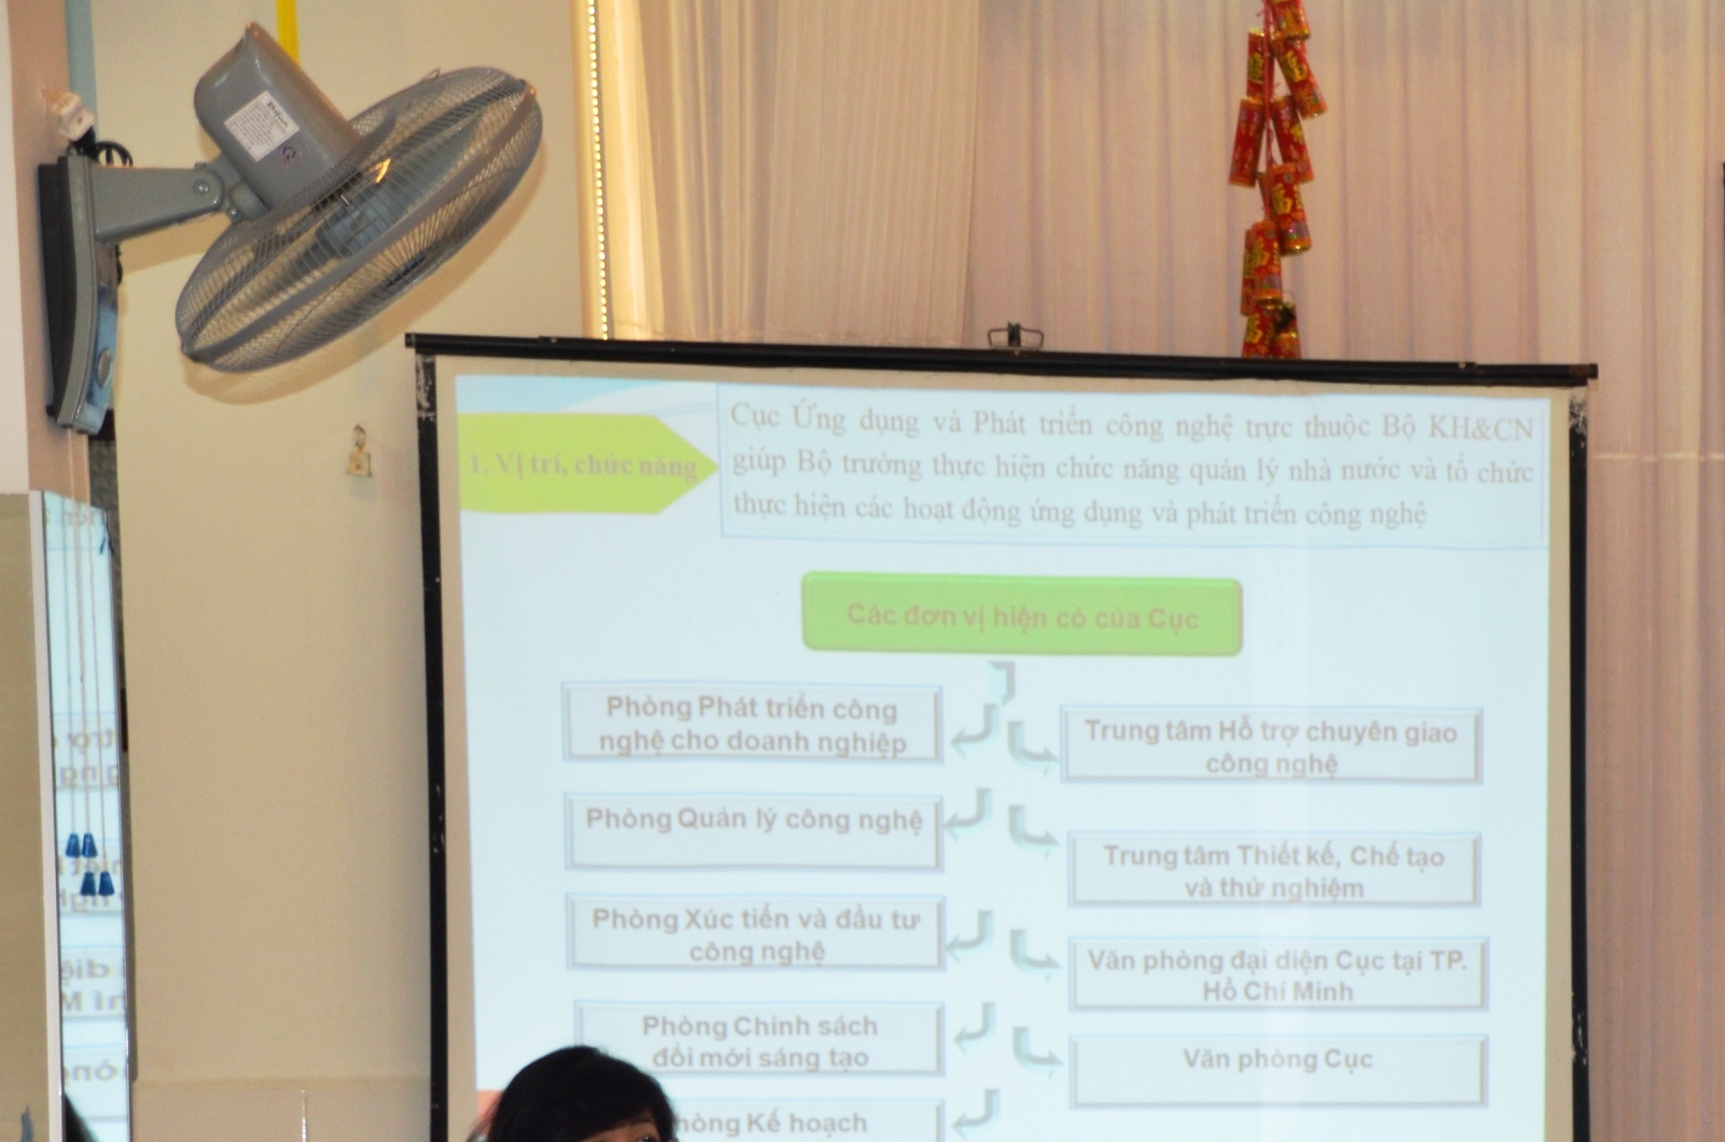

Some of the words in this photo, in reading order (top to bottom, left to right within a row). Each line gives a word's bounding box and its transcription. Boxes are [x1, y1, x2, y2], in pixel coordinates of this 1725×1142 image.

[730, 401, 780, 434] Cục
[793, 398, 847, 437] Ứng
[859, 411, 920, 438] dụng
[933, 409, 962, 435] và
[974, 408, 1026, 435] Phát
[1039, 404, 1093, 437] triển
[1106, 413, 1164, 441] công
[1175, 412, 1234, 443] nghệ
[1246, 416, 1293, 441] trực
[1304, 413, 1371, 441] thuộc
[1382, 413, 1416, 442] Bộ
[1429, 414, 1535, 441] KH&CN
[732, 449, 787, 478] giúp
[797, 449, 833, 478] Bộ
[842, 450, 924, 481] trưởng
[932, 452, 985, 480] thực
[996, 450, 1046, 481] hiện
[1056, 456, 1114, 481] chức
[1123, 458, 1181, 487] năng
[1189, 458, 1248, 487] quản
[1256, 457, 1280, 488] lý
[1288, 457, 1333, 483] nhà
[1340, 457, 1401, 482] nước
[1411, 460, 1438, 483] và
[1446, 449, 1469, 483] tổ
[1477, 459, 1535, 485] chức
[846, 601, 897, 626] Các
[904, 602, 958, 627] đơn
[963, 604, 987, 633] vị
[994, 603, 1049, 632] hiện
[1056, 607, 1087, 630] có
[1094, 607, 1142, 631] của
[1148, 607, 1200, 635] Cục
[605, 694, 693, 724] Phòng
[698, 694, 758, 720] Phát
[765, 689, 827, 722] triển
[832, 698, 899, 726] công
[599, 727, 666, 755] nghệ
[671, 728, 720, 753] cho
[727, 728, 810, 754] doanh
[817, 729, 908, 757] nghiệp
[1084, 718, 1161, 745] Trung
[1165, 717, 1213, 742] tâm
[1218, 714, 1254, 742] Hỗ
[1260, 721, 1300, 747] trợ
[1306, 719, 1398, 748] chuyên
[1405, 721, 1459, 748] giao
[585, 806, 672, 834] Phòng
[678, 805, 747, 830] Quản
[756, 805, 779, 834] lý
[785, 808, 851, 835] công
[858, 809, 924, 836] nghệ
[1103, 844, 1179, 871] Trung
[1184, 845, 1230, 866] tâm
[1237, 840, 1300, 866] Thiết
[1305, 840, 1342, 870] kế,
[1350, 840, 1400, 867] Chế
[1406, 847, 1445, 873] tạo
[591, 908, 679, 935] Phòng
[684, 905, 735, 930] Xúc
[741, 901, 790, 930] tiến
[798, 907, 828, 930] và
[835, 902, 884, 931] đầu
[892, 909, 921, 931] tư
[1087, 948, 1136, 971] Văn
[1142, 948, 1225, 976] phòng
[1230, 948, 1268, 977] đại
[1274, 949, 1329, 977] diện
[1335, 950, 1385, 977] Cục
[1392, 950, 1423, 977] tại
[1430, 950, 1468, 971] TP.
[1202, 978, 1238, 1003] Hồ
[1243, 980, 1287, 1002] Chí
[1292, 981, 1354, 1003] Minh
[641, 1015, 728, 1041] Phòng
[733, 1013, 811, 1037] Chính
[817, 1015, 879, 1038] sách
[652, 1043, 694, 1068] đổi
[699, 1046, 752, 1069] mới
[758, 1046, 821, 1073] sáng
[828, 1048, 869, 1072] tạo
[1183, 1047, 1231, 1070] Văn
[1238, 1048, 1318, 1075] phòng
[1323, 1048, 1374, 1075] Cục
[675, 1111, 740, 1138] hòng
[746, 1107, 782, 1134] Kế
[789, 1112, 867, 1139] hoạch
